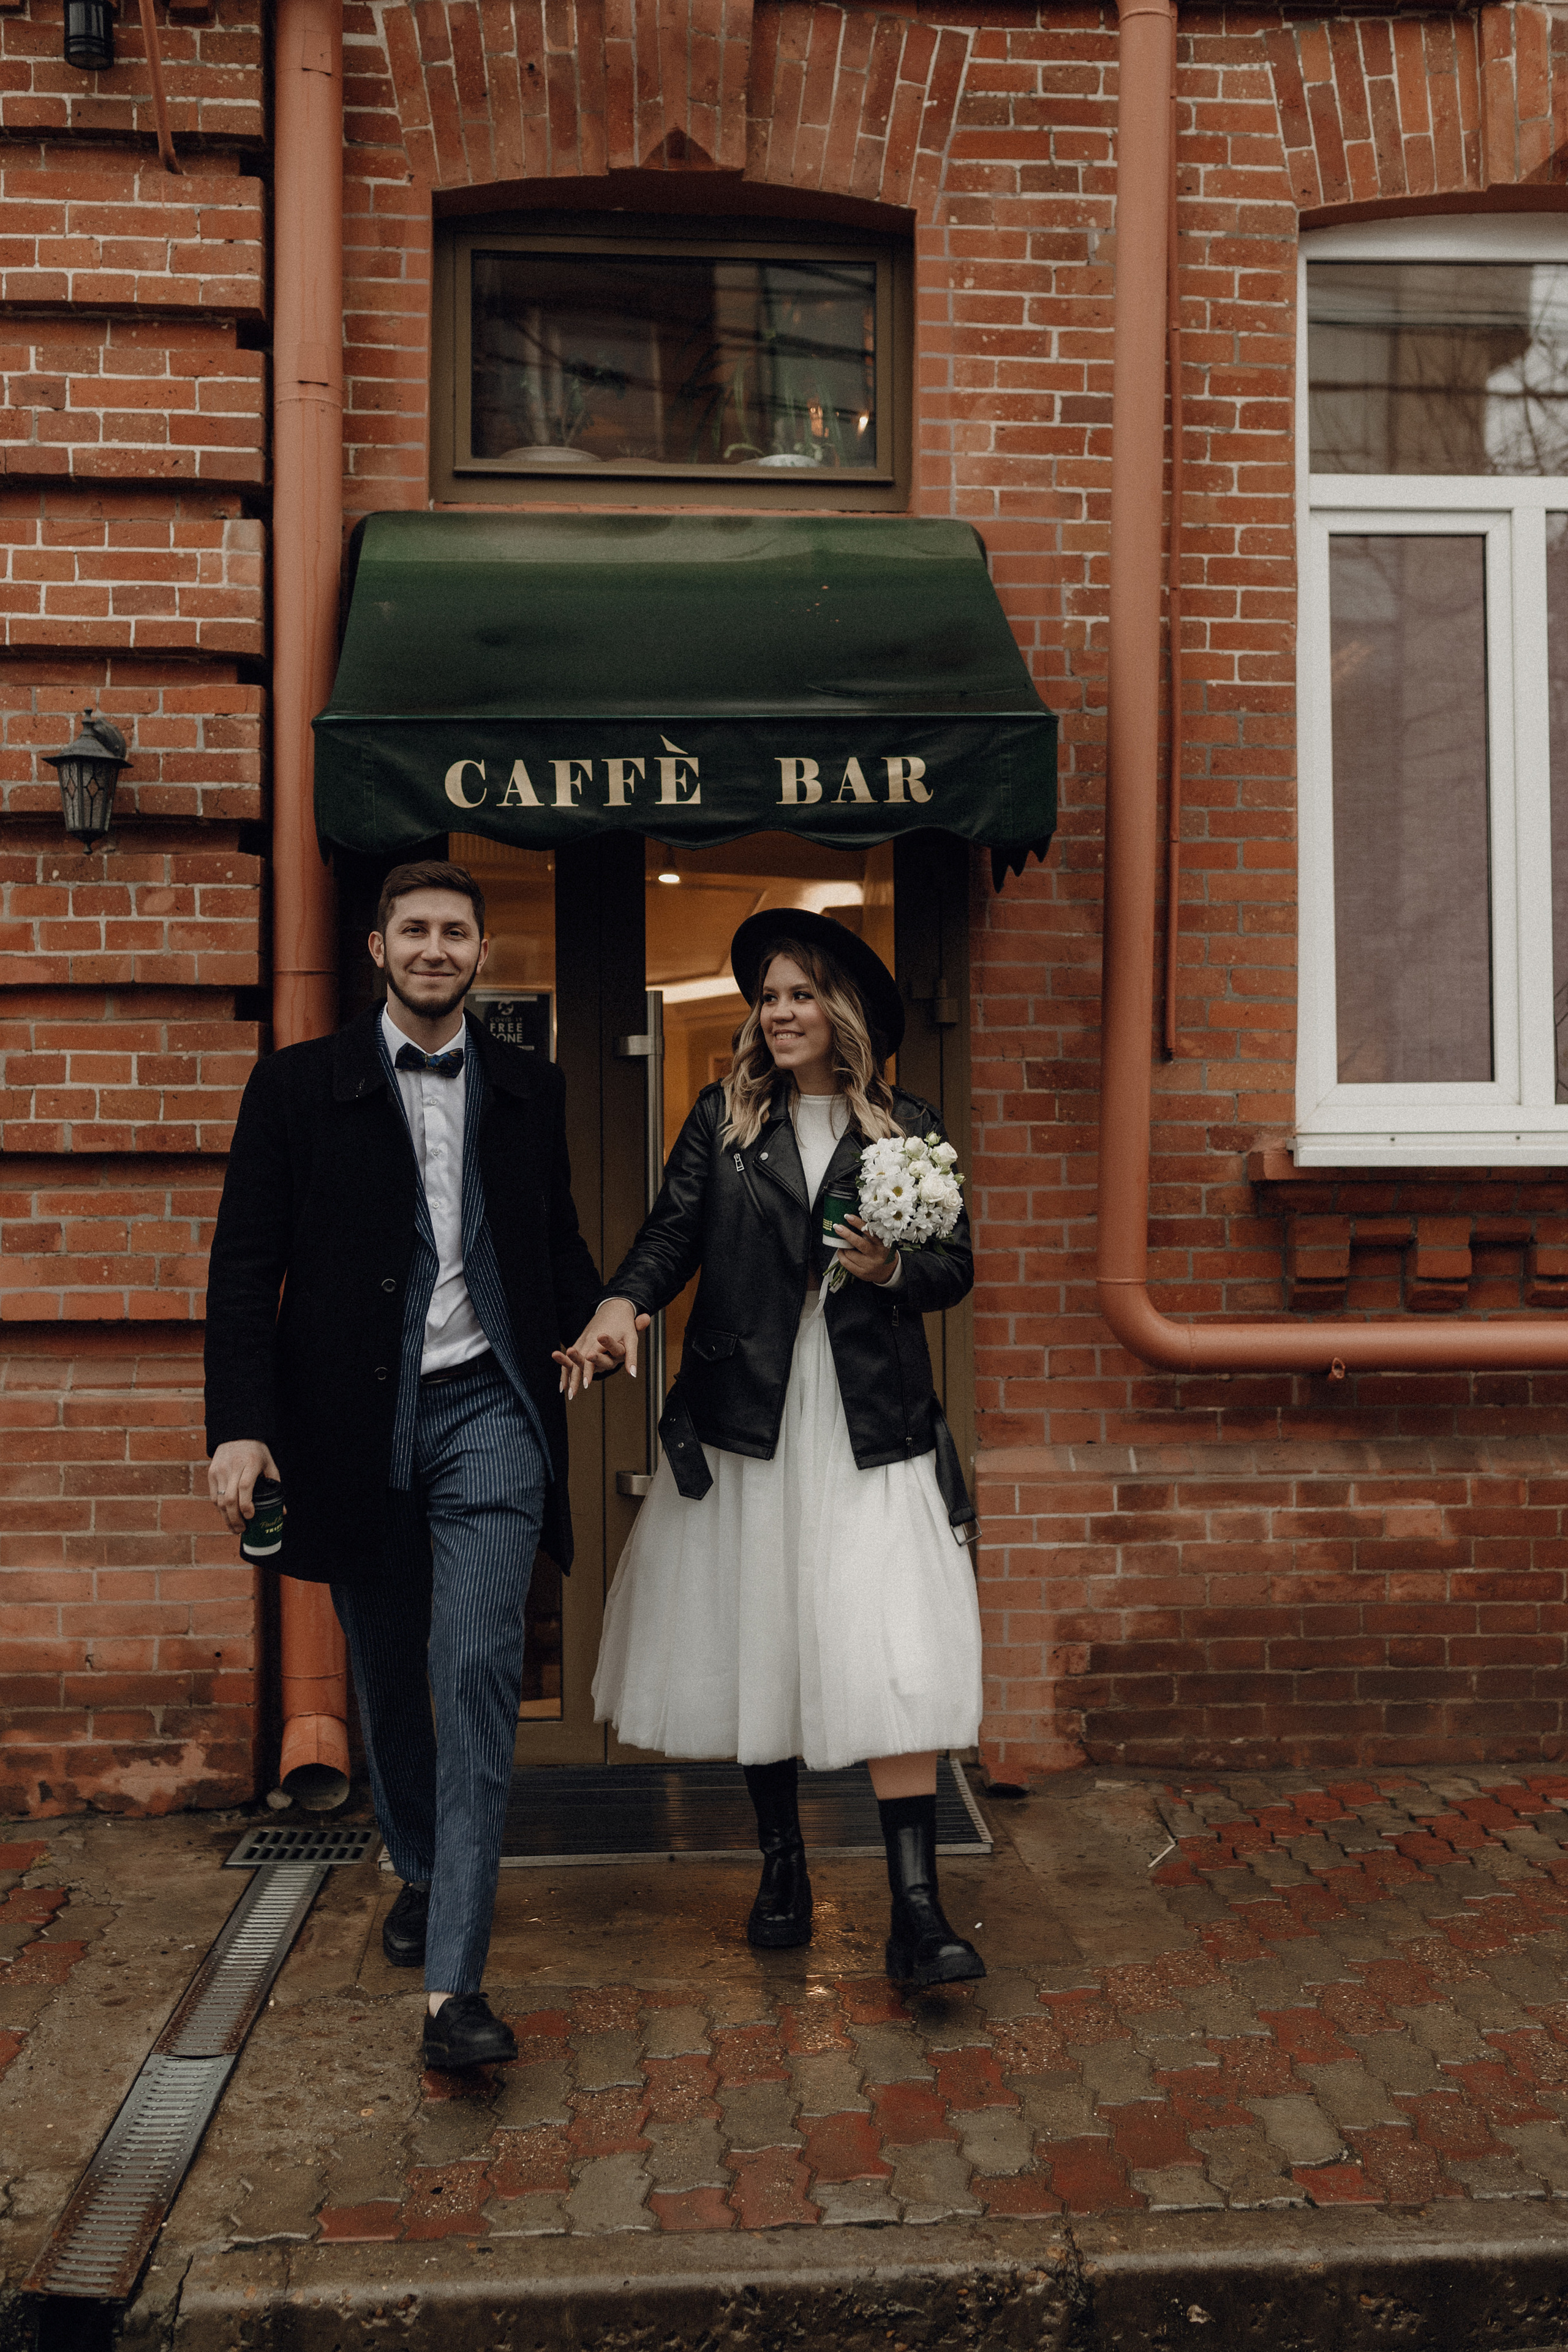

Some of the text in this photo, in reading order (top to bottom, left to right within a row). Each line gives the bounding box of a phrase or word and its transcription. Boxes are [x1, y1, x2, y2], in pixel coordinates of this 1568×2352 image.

[444, 735, 933, 809] CAFFÈ BAR
[490, 1023, 522, 1033] FREE
